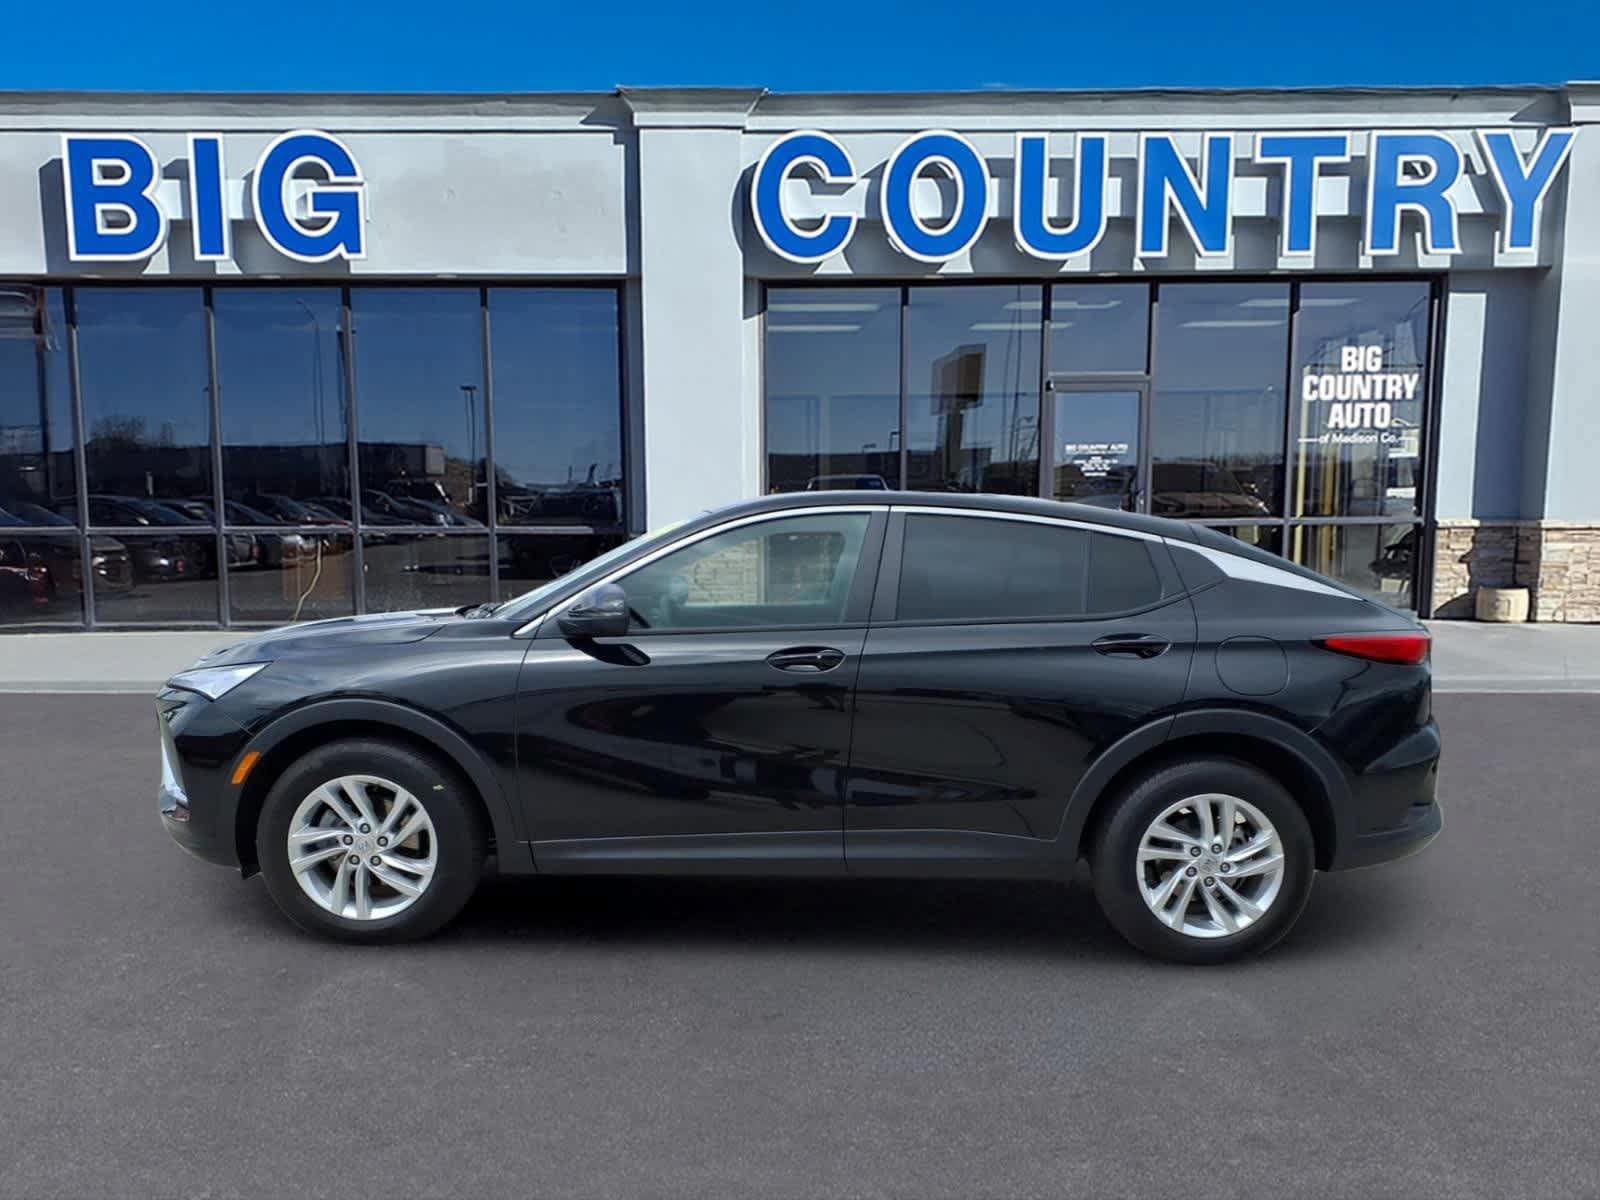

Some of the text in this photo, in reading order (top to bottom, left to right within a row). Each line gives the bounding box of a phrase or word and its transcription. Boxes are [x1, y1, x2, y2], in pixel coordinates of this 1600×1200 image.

[61, 128, 1577, 263] BIG COUNTRY
[1342, 346, 1382, 372] BIG
[1303, 375, 1418, 400] COUNTRY
[1328, 403, 1391, 428] AUTO
[1319, 433, 1330, 444] of
[1331, 433, 1378, 443] Madison
